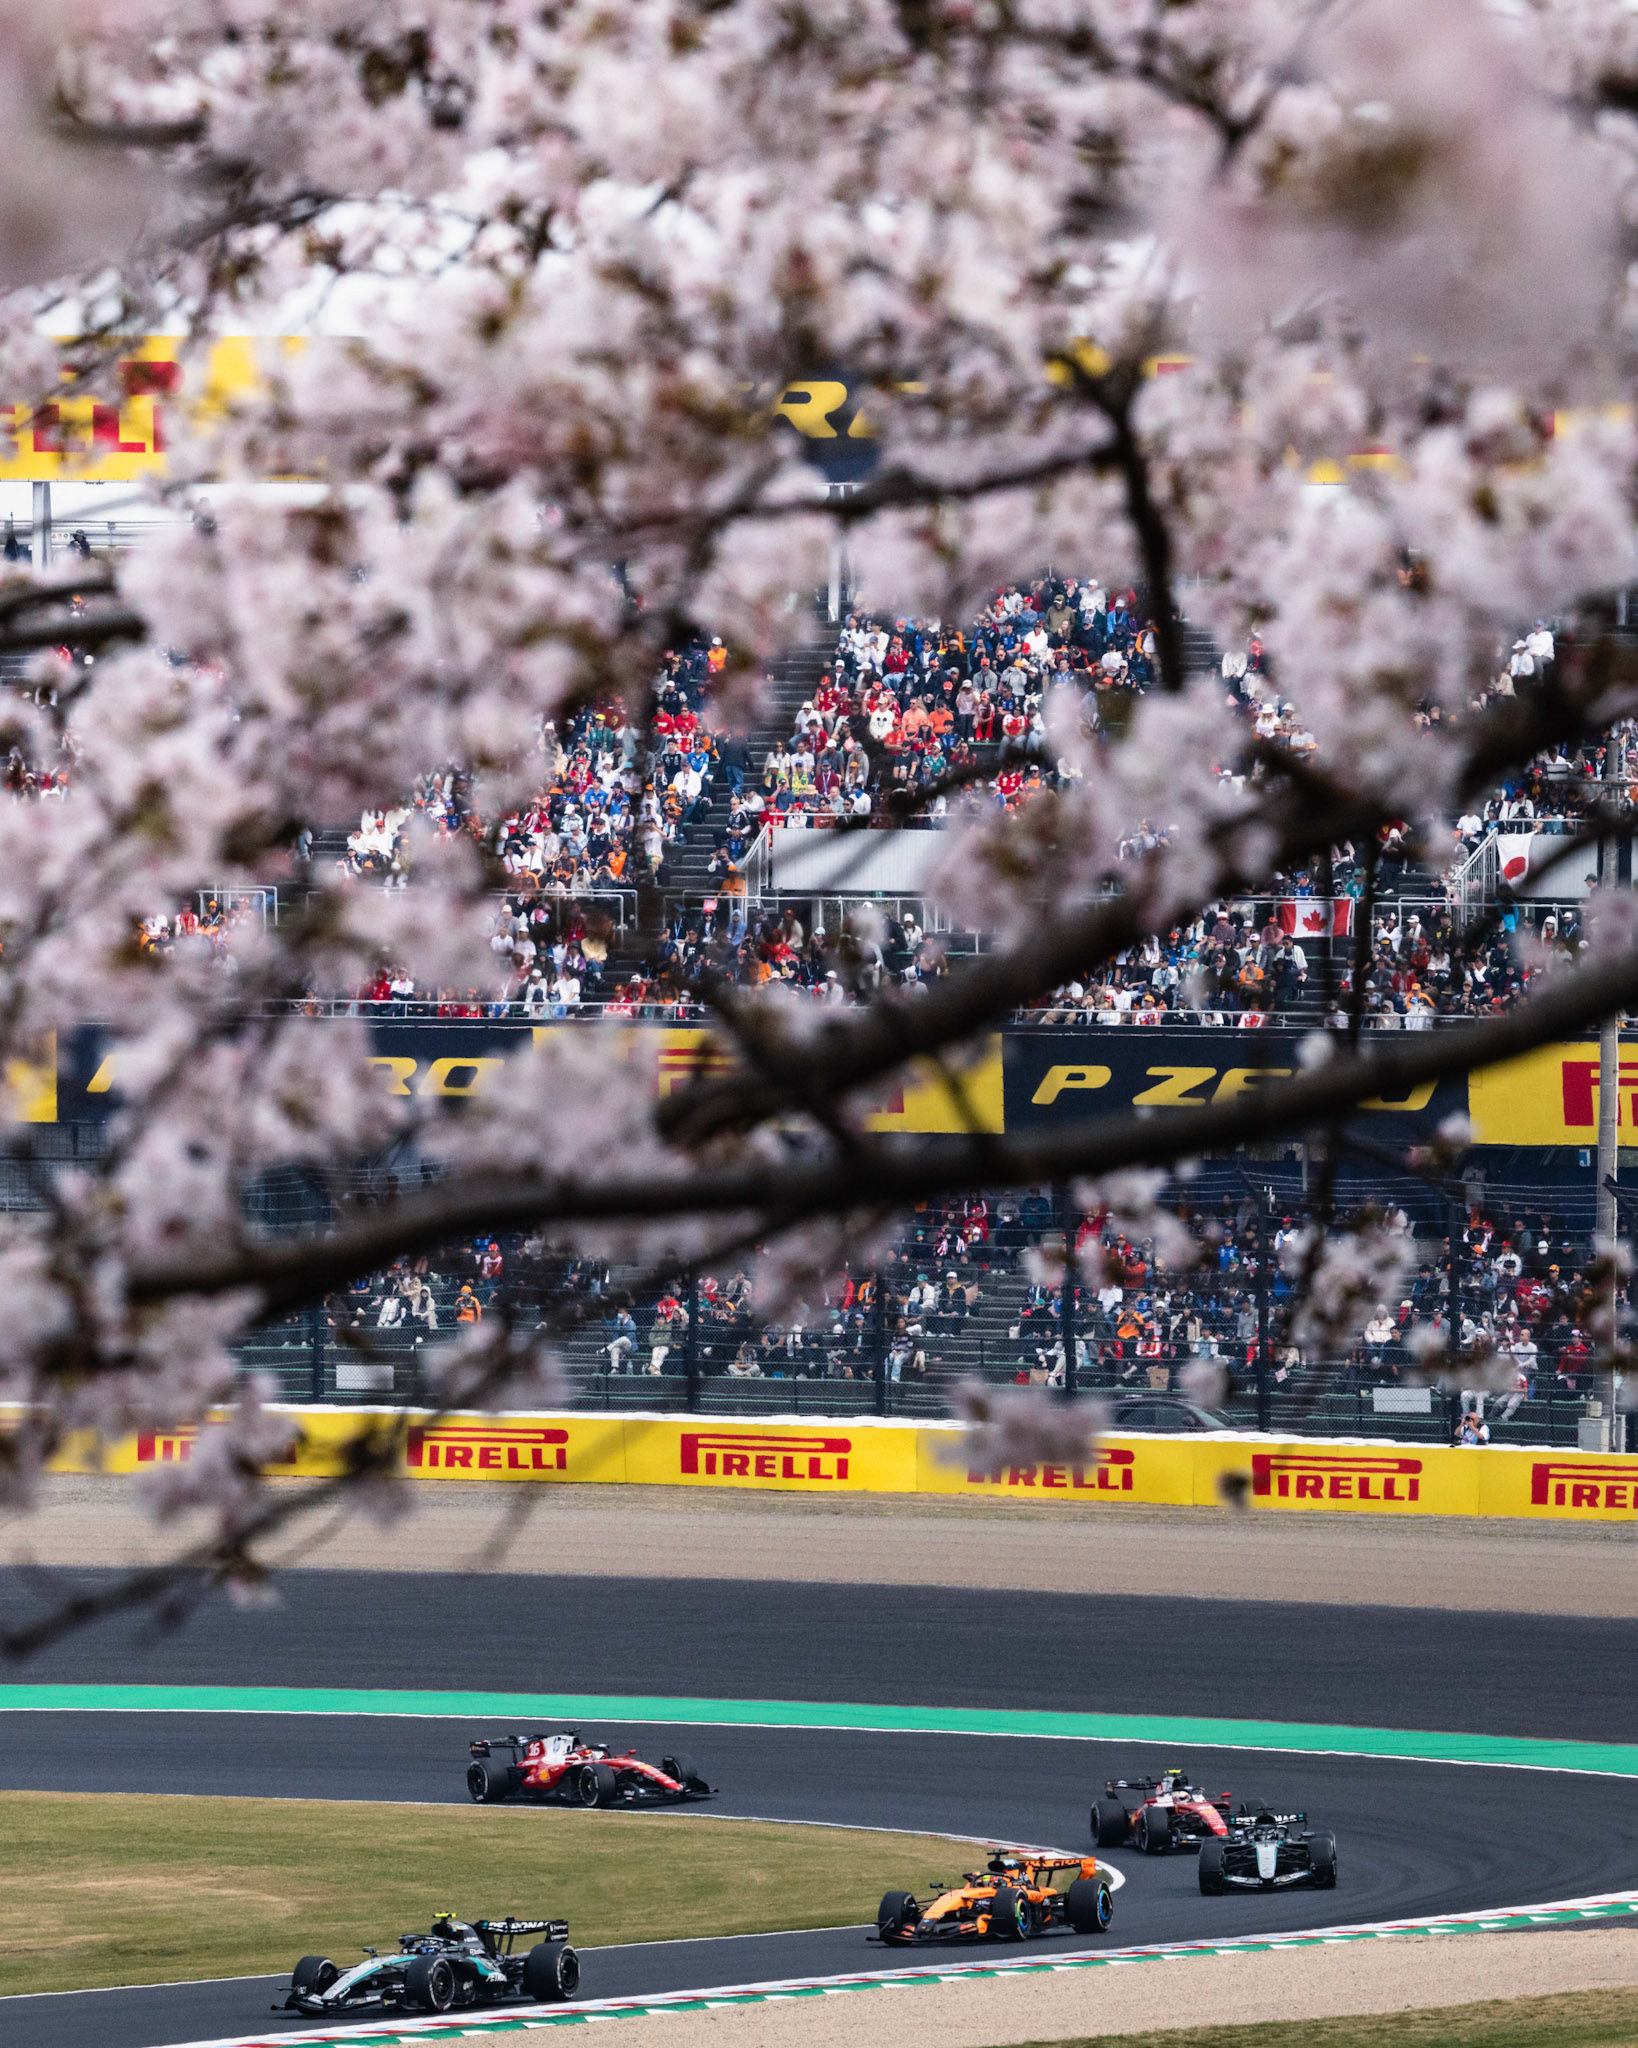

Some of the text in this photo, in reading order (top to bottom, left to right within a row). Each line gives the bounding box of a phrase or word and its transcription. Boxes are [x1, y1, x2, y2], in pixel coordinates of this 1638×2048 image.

[1032, 1065, 1112, 1105] P
[407, 1426, 568, 1470] PIRELLI
[681, 1433, 852, 1479] PIRELLI
[1252, 1454, 1422, 1501] PIRELLI
[528, 1742, 540, 1757] 16
